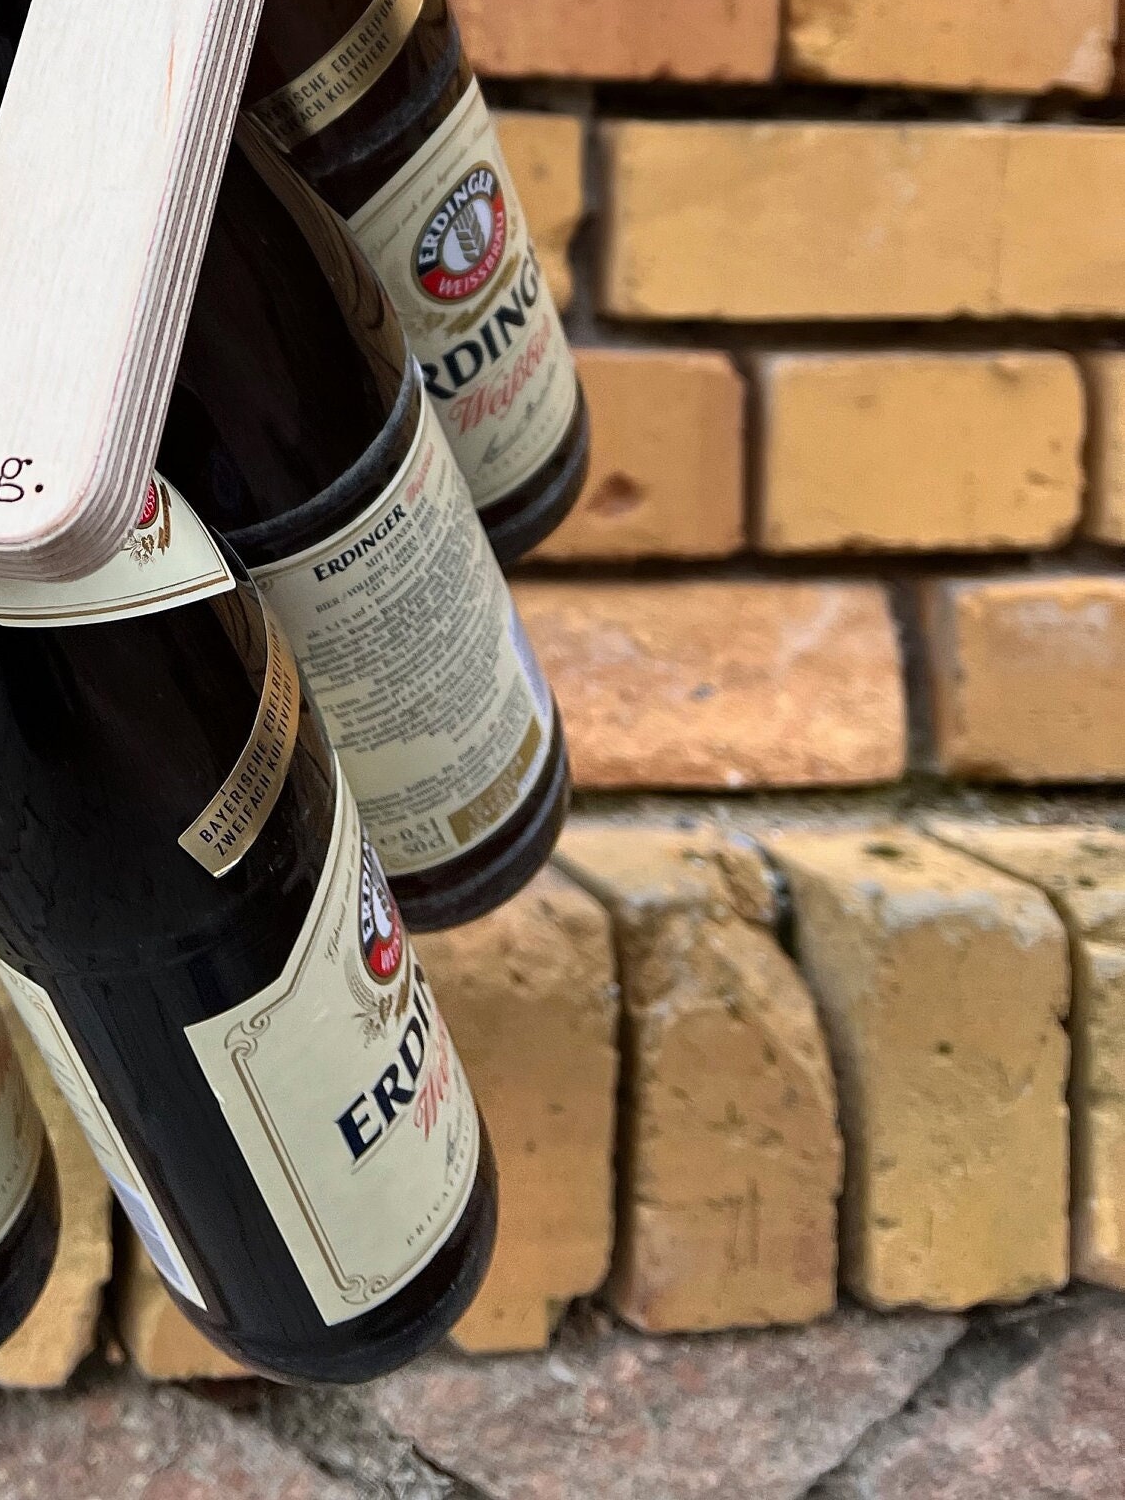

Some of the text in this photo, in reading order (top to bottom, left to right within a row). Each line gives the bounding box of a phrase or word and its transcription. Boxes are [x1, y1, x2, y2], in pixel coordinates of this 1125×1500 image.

[325, 32, 391, 105] KULTIVIERT
[418, 169, 494, 265] ERDINGER
[312, 503, 408, 582] ERDINGER
[198, 739, 268, 845] BAYERISCHE
[213, 774, 271, 857] ZWEIFACH
